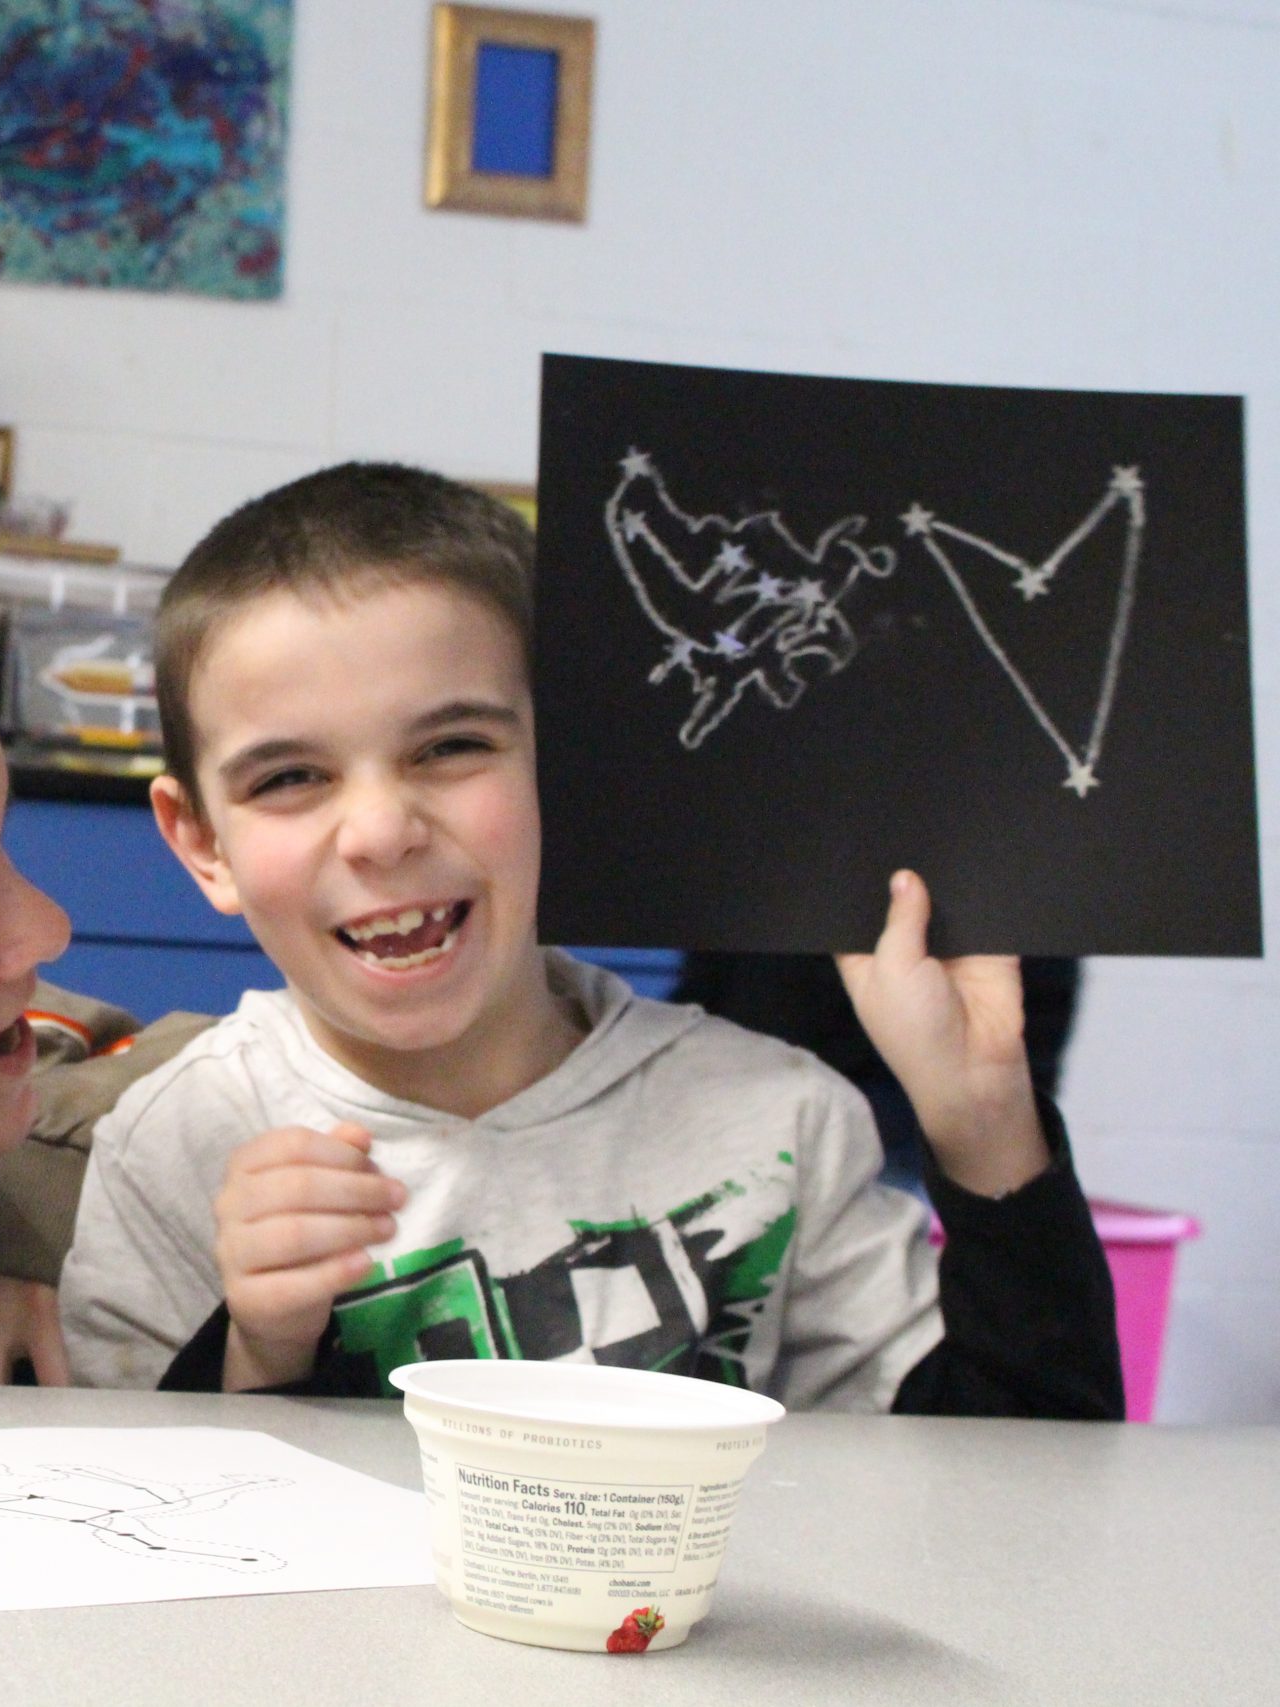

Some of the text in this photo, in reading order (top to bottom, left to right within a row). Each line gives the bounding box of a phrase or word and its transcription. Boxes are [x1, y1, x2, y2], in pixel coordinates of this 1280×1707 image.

[500, 1429, 513, 1439] OF
[523, 1433, 602, 1450] PROBIOTICS
[716, 1440, 750, 1450] PROTEIN
[458, 1468, 509, 1491] Nutrition
[513, 1479, 550, 1497] Facts
[553, 1489, 577, 1500] Serv.
[580, 1492, 601, 1501] size:
[604, 1493, 608, 1502] 1
[610, 1493, 655, 1503] Container
[522, 1499, 561, 1513] Calories
[591, 1508, 610, 1517] Total
[612, 1509, 625, 1518] Fat
[485, 1520, 501, 1530] Total
[552, 1517, 583, 1528] Cholest.
[635, 1522, 662, 1531] Sodium
[567, 1544, 595, 1554] Protein
[540, 1573, 550, 1581] NY
